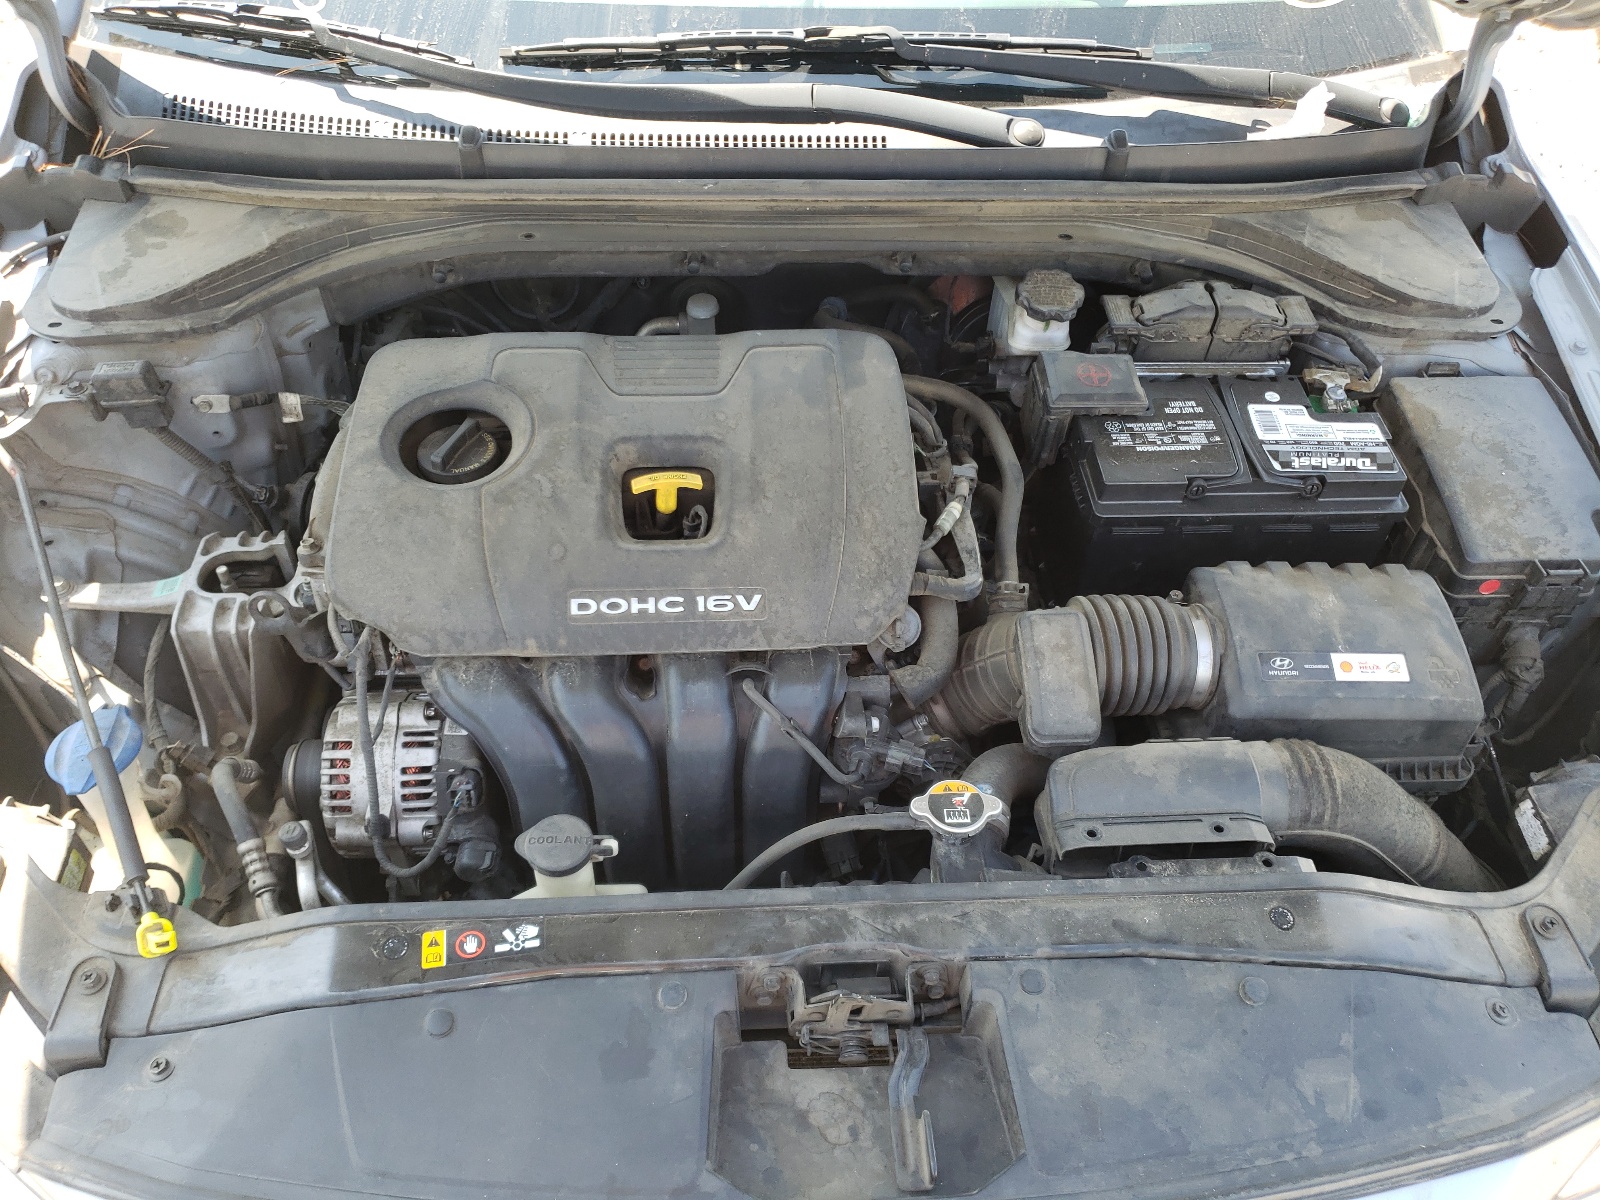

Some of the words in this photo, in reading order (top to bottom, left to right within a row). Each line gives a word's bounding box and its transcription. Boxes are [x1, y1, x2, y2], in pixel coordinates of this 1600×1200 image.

[450, 462, 480, 474] MANUAL
[1291, 457, 1377, 470] Duralast
[570, 597, 685, 615] DOHC
[696, 594, 763, 612] 16V
[528, 835, 591, 845] COOLANT
